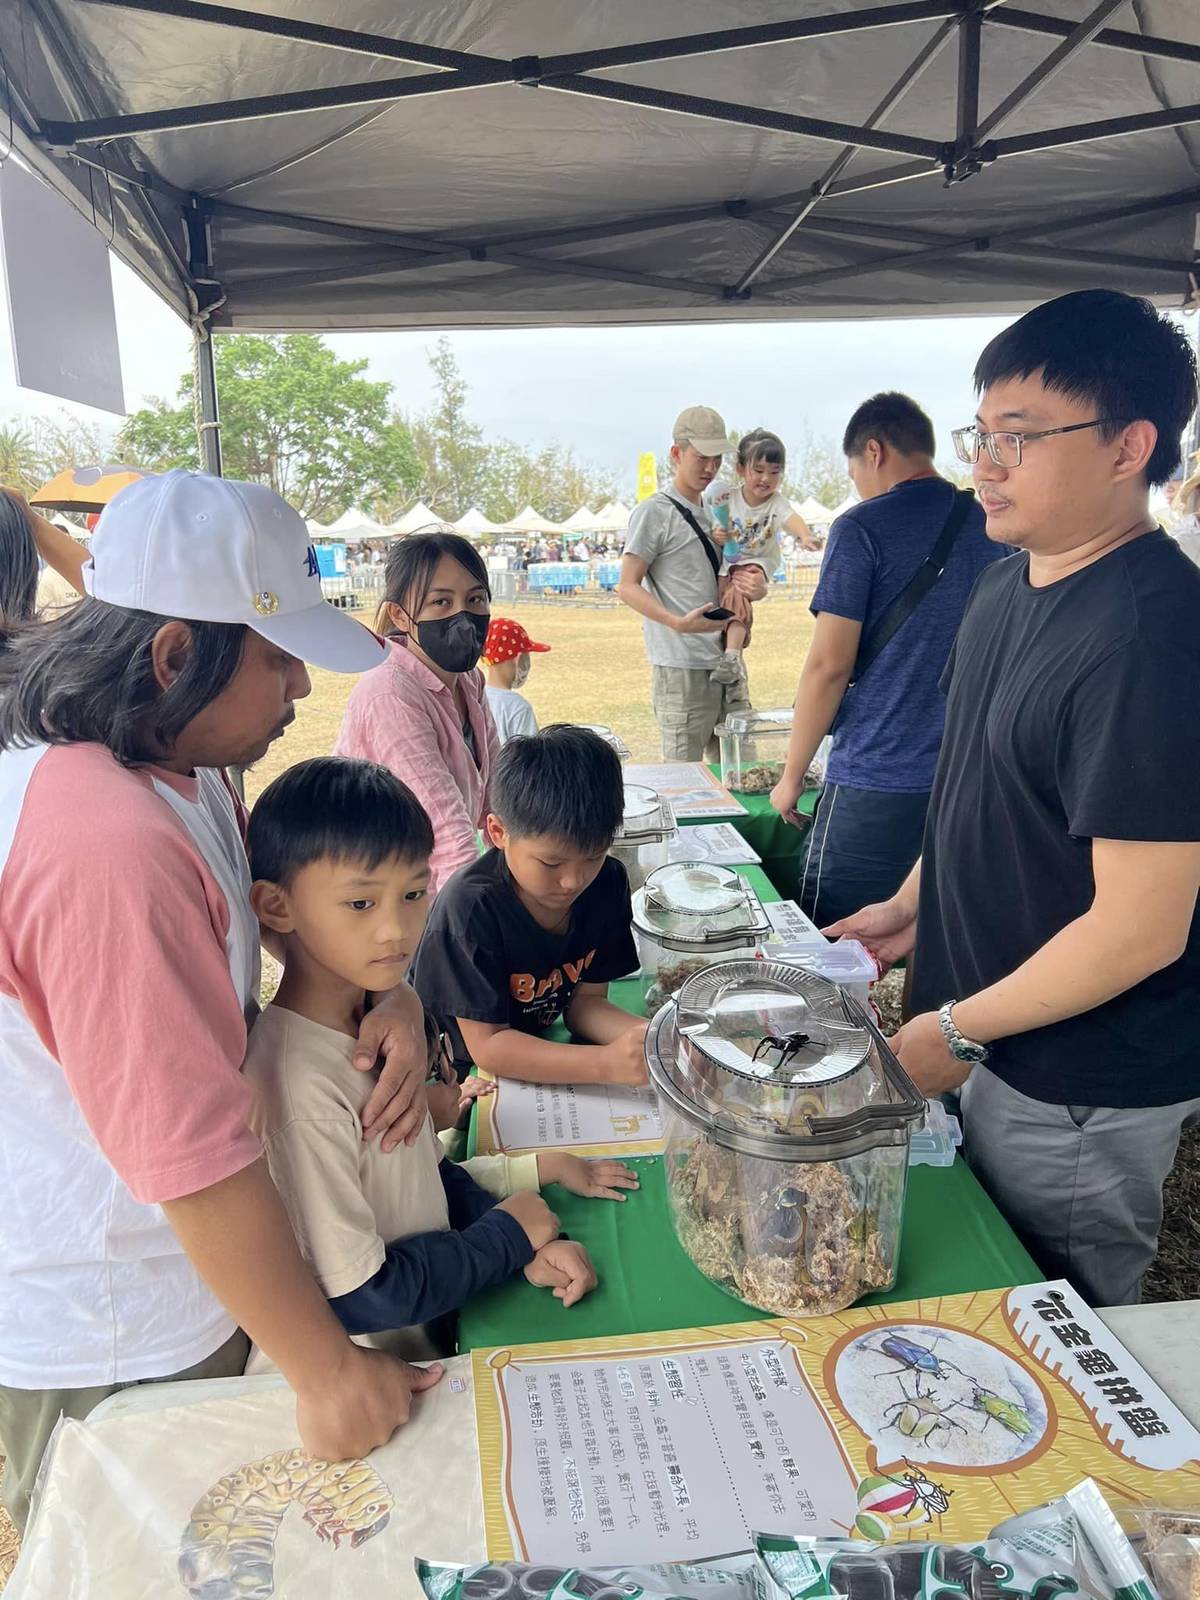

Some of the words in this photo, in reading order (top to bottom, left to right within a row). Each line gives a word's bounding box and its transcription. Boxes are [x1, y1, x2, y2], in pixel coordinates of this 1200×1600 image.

[661, 1359, 686, 1400] 生態習性
[1031, 1298, 1171, 1439] 花金龜拼盤
